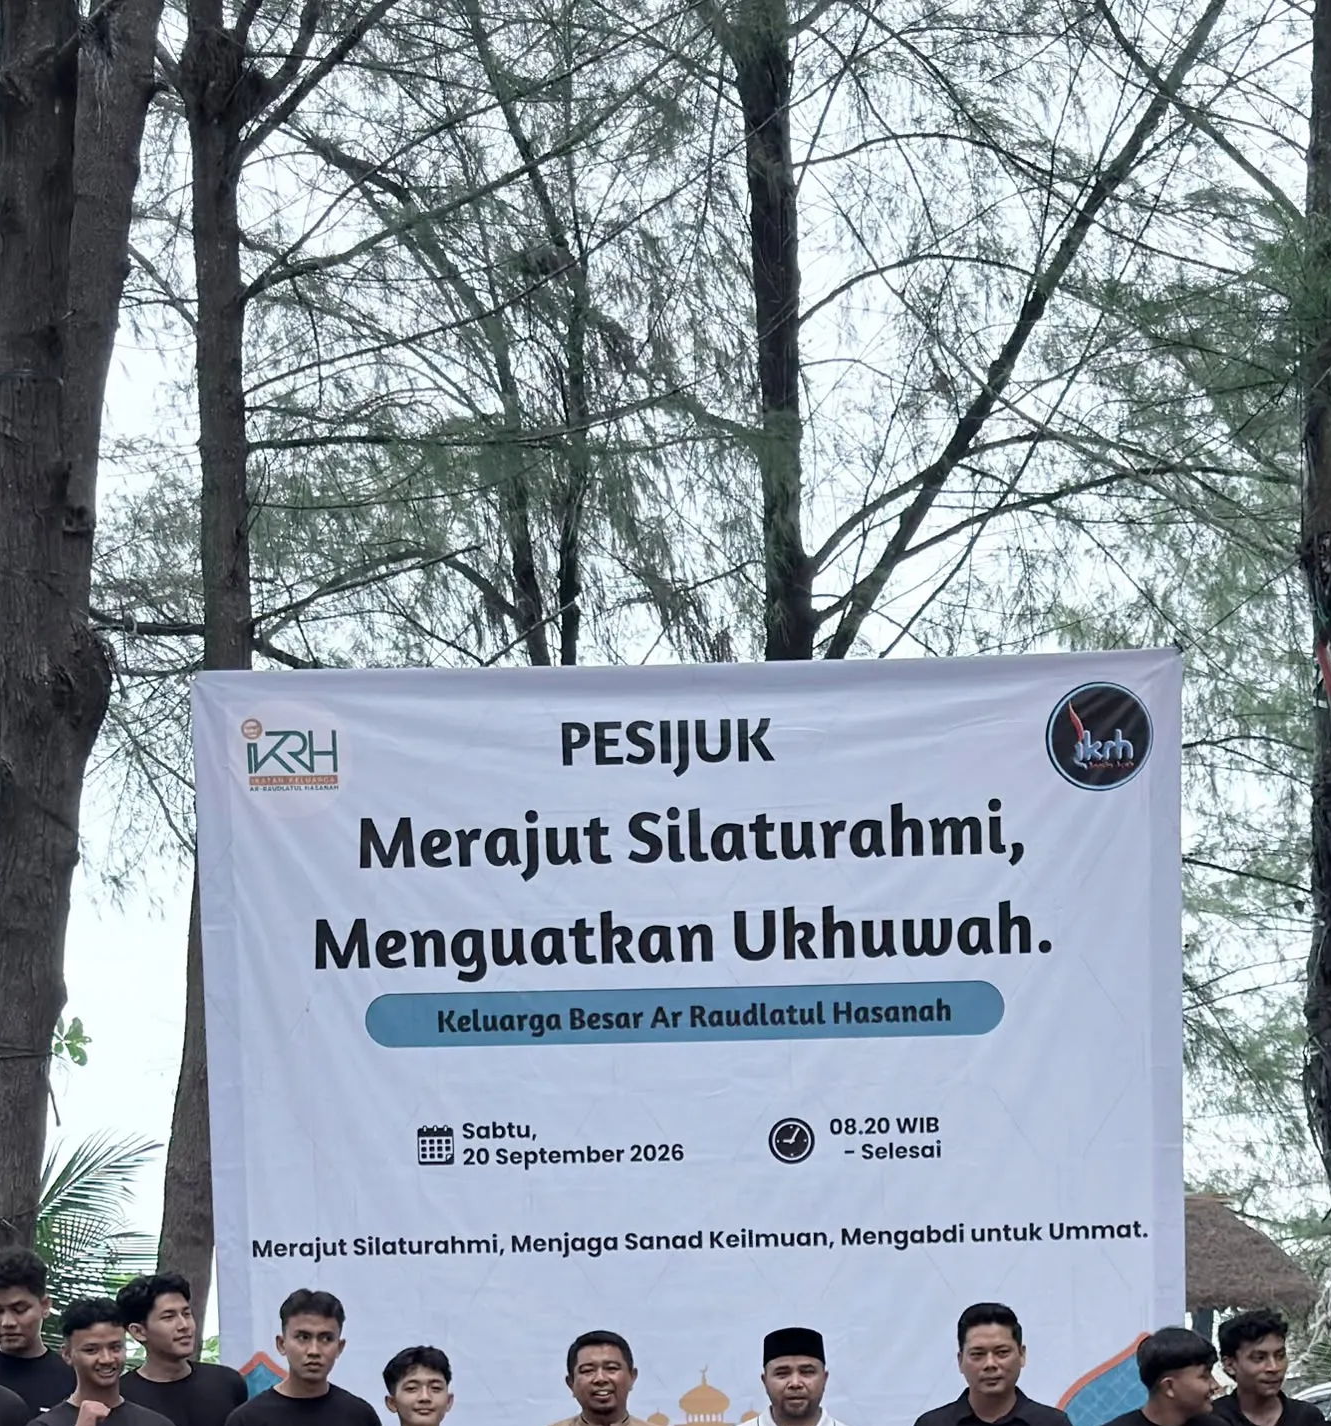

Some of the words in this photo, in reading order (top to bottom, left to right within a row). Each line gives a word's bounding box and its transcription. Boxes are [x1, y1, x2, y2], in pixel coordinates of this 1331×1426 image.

[562, 718, 774, 777] PESIJUK
[360, 810, 612, 881] Merajut
[629, 799, 1024, 866] Silaturahmi,
[315, 911, 713, 982] Menguatkan
[734, 900, 1051, 962] Ukhuwah.
[436, 1008, 562, 1038] Keluarga
[570, 1005, 643, 1031] Besar
[651, 1006, 682, 1028] Ar
[690, 1001, 826, 1028] Raudlatul
[834, 998, 951, 1025] Hasanah
[463, 1122, 536, 1142] Sabtu,
[830, 1118, 889, 1135] 08.20
[896, 1117, 939, 1134] WIB
[463, 1148, 489, 1166] 20
[496, 1146, 624, 1170] September
[631, 1144, 683, 1162] 2026
[862, 1140, 941, 1160] Selesai
[253, 1237, 347, 1262] Merajut
[354, 1234, 504, 1257] Silaturahmi,
[512, 1232, 617, 1258] Menjaga
[625, 1231, 702, 1251] Sanad
[710, 1229, 834, 1250] Keilmuan,
[842, 1223, 964, 1250] Mengabdi
[972, 1223, 1042, 1243] untuk
[1050, 1221, 1147, 1241] Ummat.
